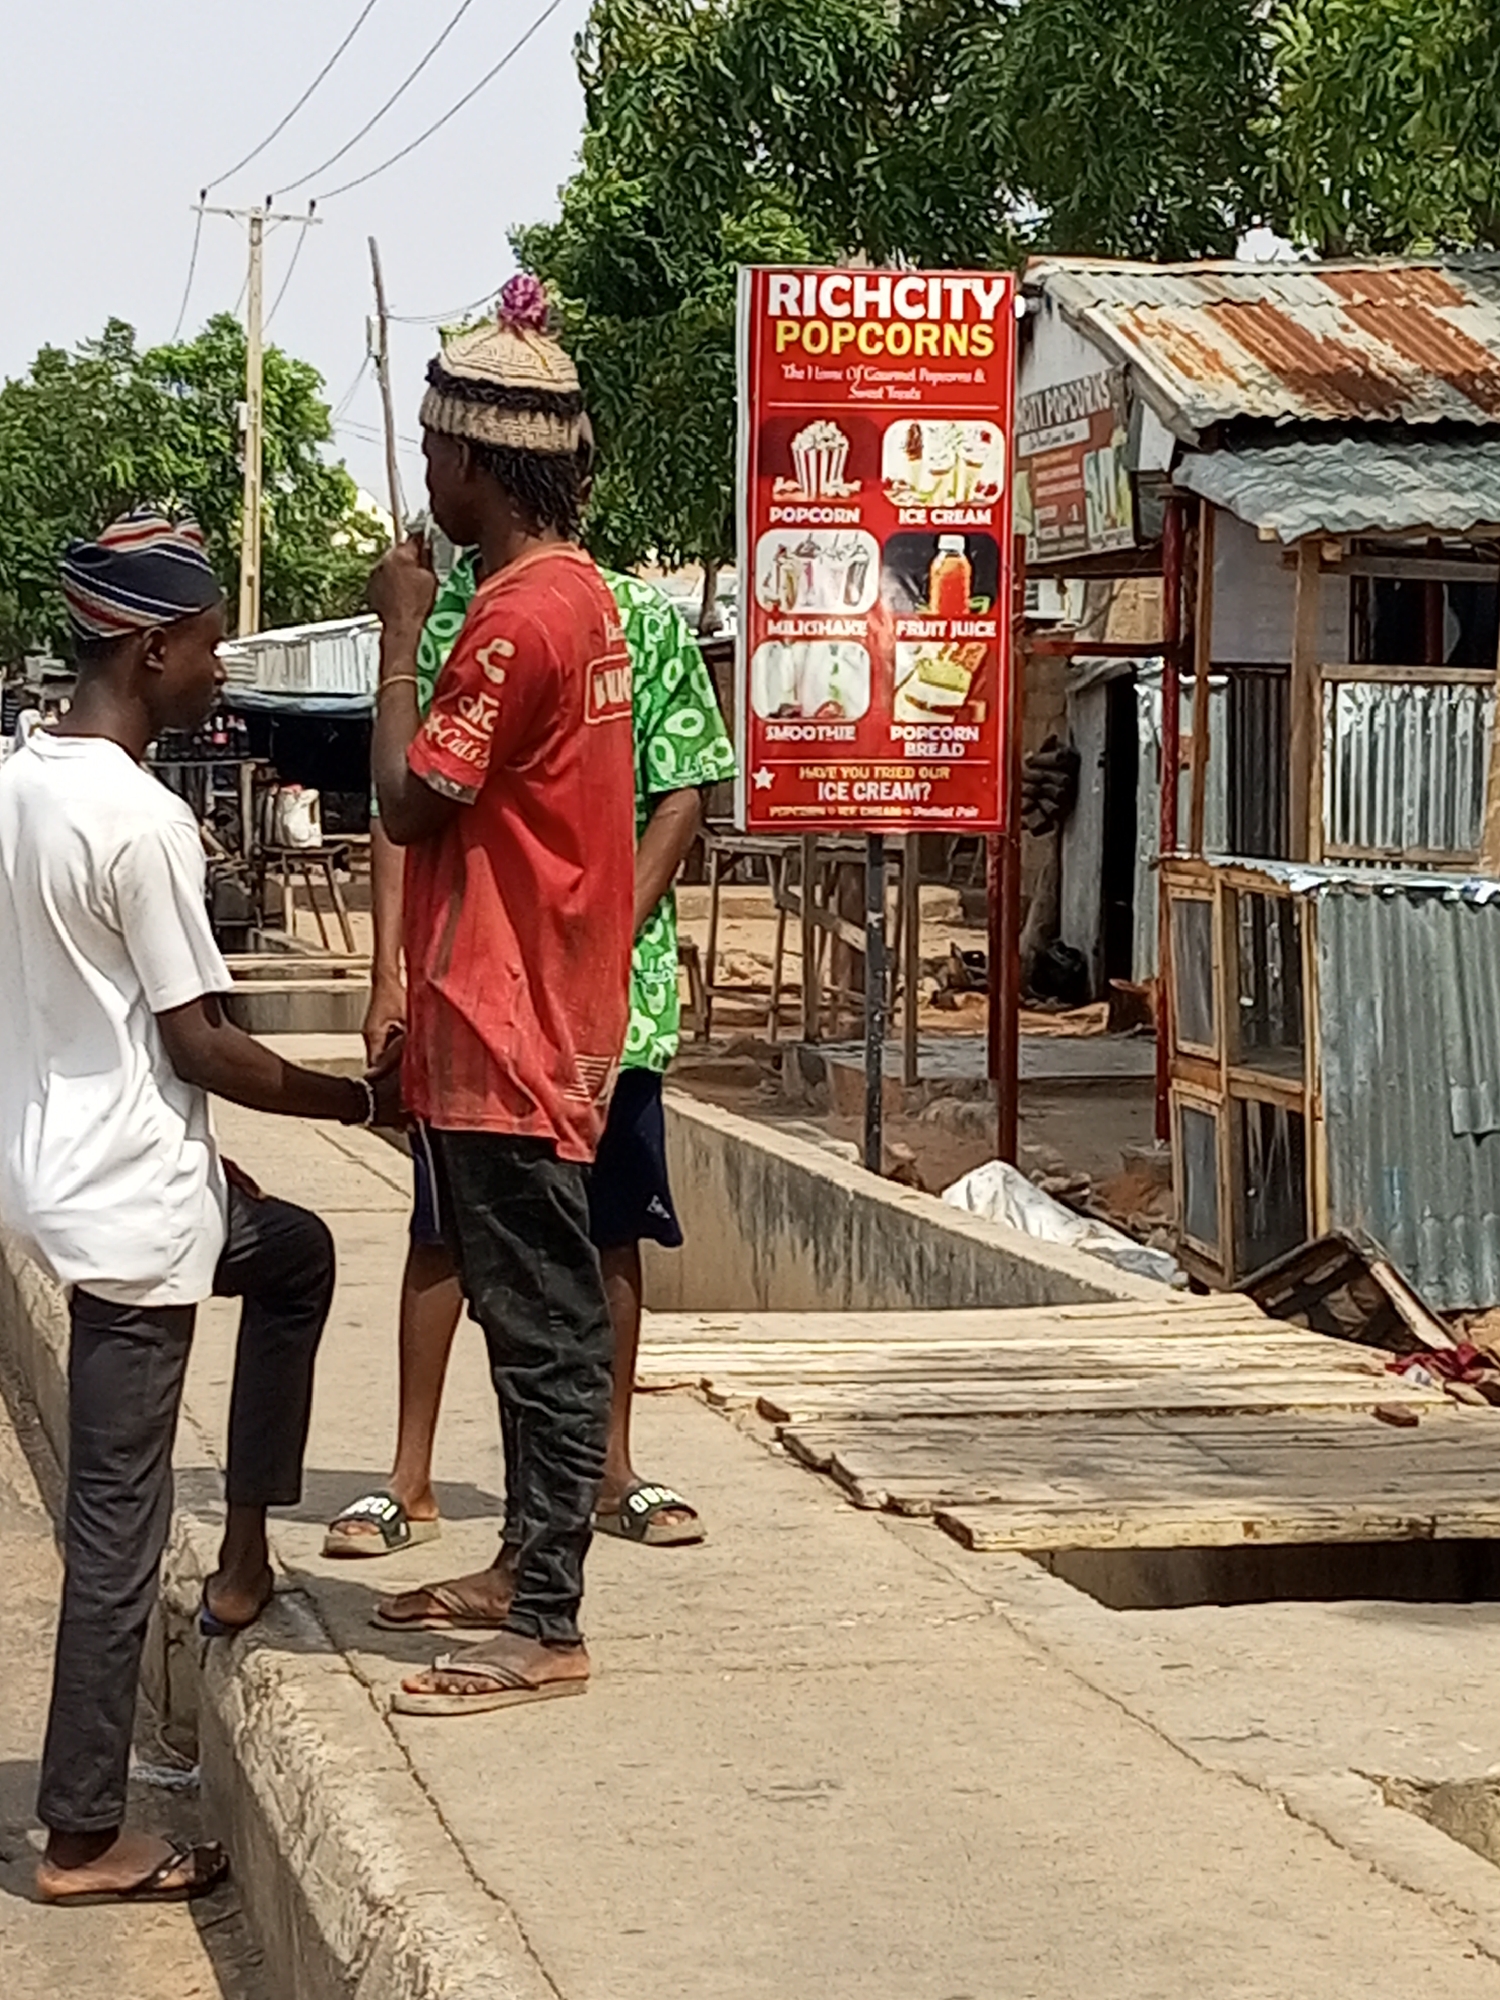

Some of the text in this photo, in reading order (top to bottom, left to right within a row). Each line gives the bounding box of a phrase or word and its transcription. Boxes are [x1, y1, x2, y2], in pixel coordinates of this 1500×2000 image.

[767, 274, 1005, 320] RICHCITY
[776, 320, 995, 357] POPCORNS
[769, 507, 860, 523] POPCORN
[899, 508, 992, 525] ICE CREAM
[767, 620, 868, 636] MILKSHAKE
[896, 620, 996, 637] FRUIT JUICE
[765, 726, 856, 741] SMOOTHIE
[890, 726, 979, 741] POPCORN
[904, 742, 965, 757] BREAD
[799, 766, 837, 779] HAVE
[840, 766, 870, 779] YOU
[919, 767, 950, 779] OUR
[818, 782, 932, 802] ICE CREAM?
